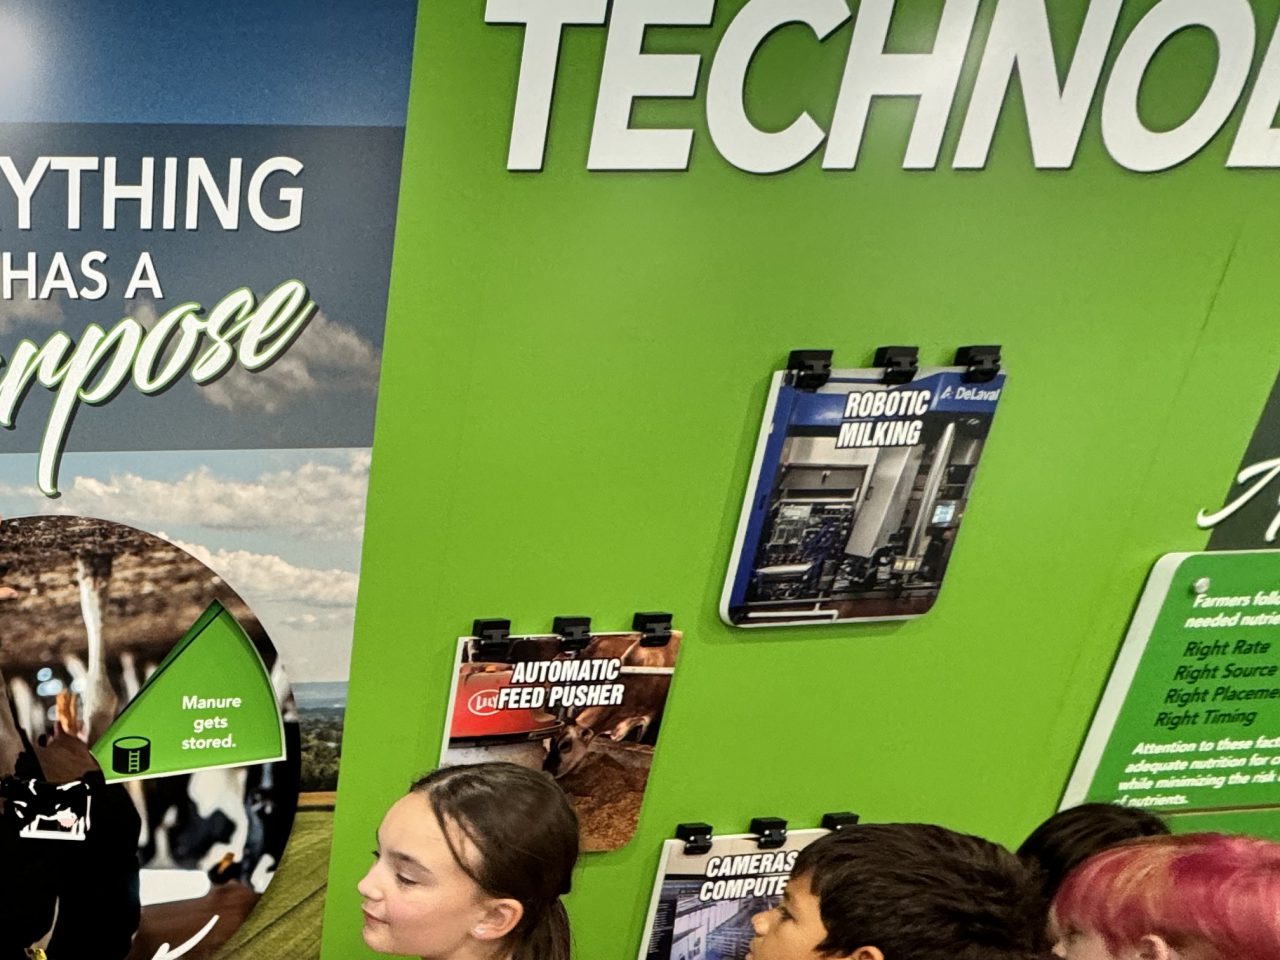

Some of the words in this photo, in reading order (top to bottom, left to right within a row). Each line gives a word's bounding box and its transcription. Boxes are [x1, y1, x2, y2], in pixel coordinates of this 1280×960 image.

[3, 251, 107, 299] HAS
[124, 252, 162, 298] A
[844, 391, 931, 418] ROBOTIC
[955, 387, 1000, 401] DeLaval
[837, 421, 923, 447] MILKING
[1193, 594, 1251, 608] Farmers
[1184, 612, 1241, 628] needed
[1183, 640, 1230, 661] Right
[1232, 640, 1271, 654] Rate
[512, 659, 621, 684] AUTOMATIC
[1173, 664, 1219, 684] Right
[1221, 663, 1278, 678] Source
[183, 696, 241, 709] Manure
[498, 687, 545, 709] FEED
[549, 684, 625, 707] PUSHER
[1164, 687, 1209, 707] Right
[194, 717, 228, 733] gets
[1154, 710, 1199, 730] Right
[1204, 709, 1258, 726] Timing
[182, 734, 236, 749] stored.
[1132, 741, 1197, 755] Attention
[1198, 741, 1215, 751] to
[1216, 738, 1253, 750] these
[1125, 760, 1188, 774] adequate
[1189, 756, 1247, 769] nutrition
[1248, 753, 1270, 766] for
[1118, 777, 1154, 790] while
[1155, 775, 1226, 788] minimizing
[1228, 772, 1250, 784] the
[1251, 770, 1279, 783] risk
[706, 851, 798, 878] CAMERAS
